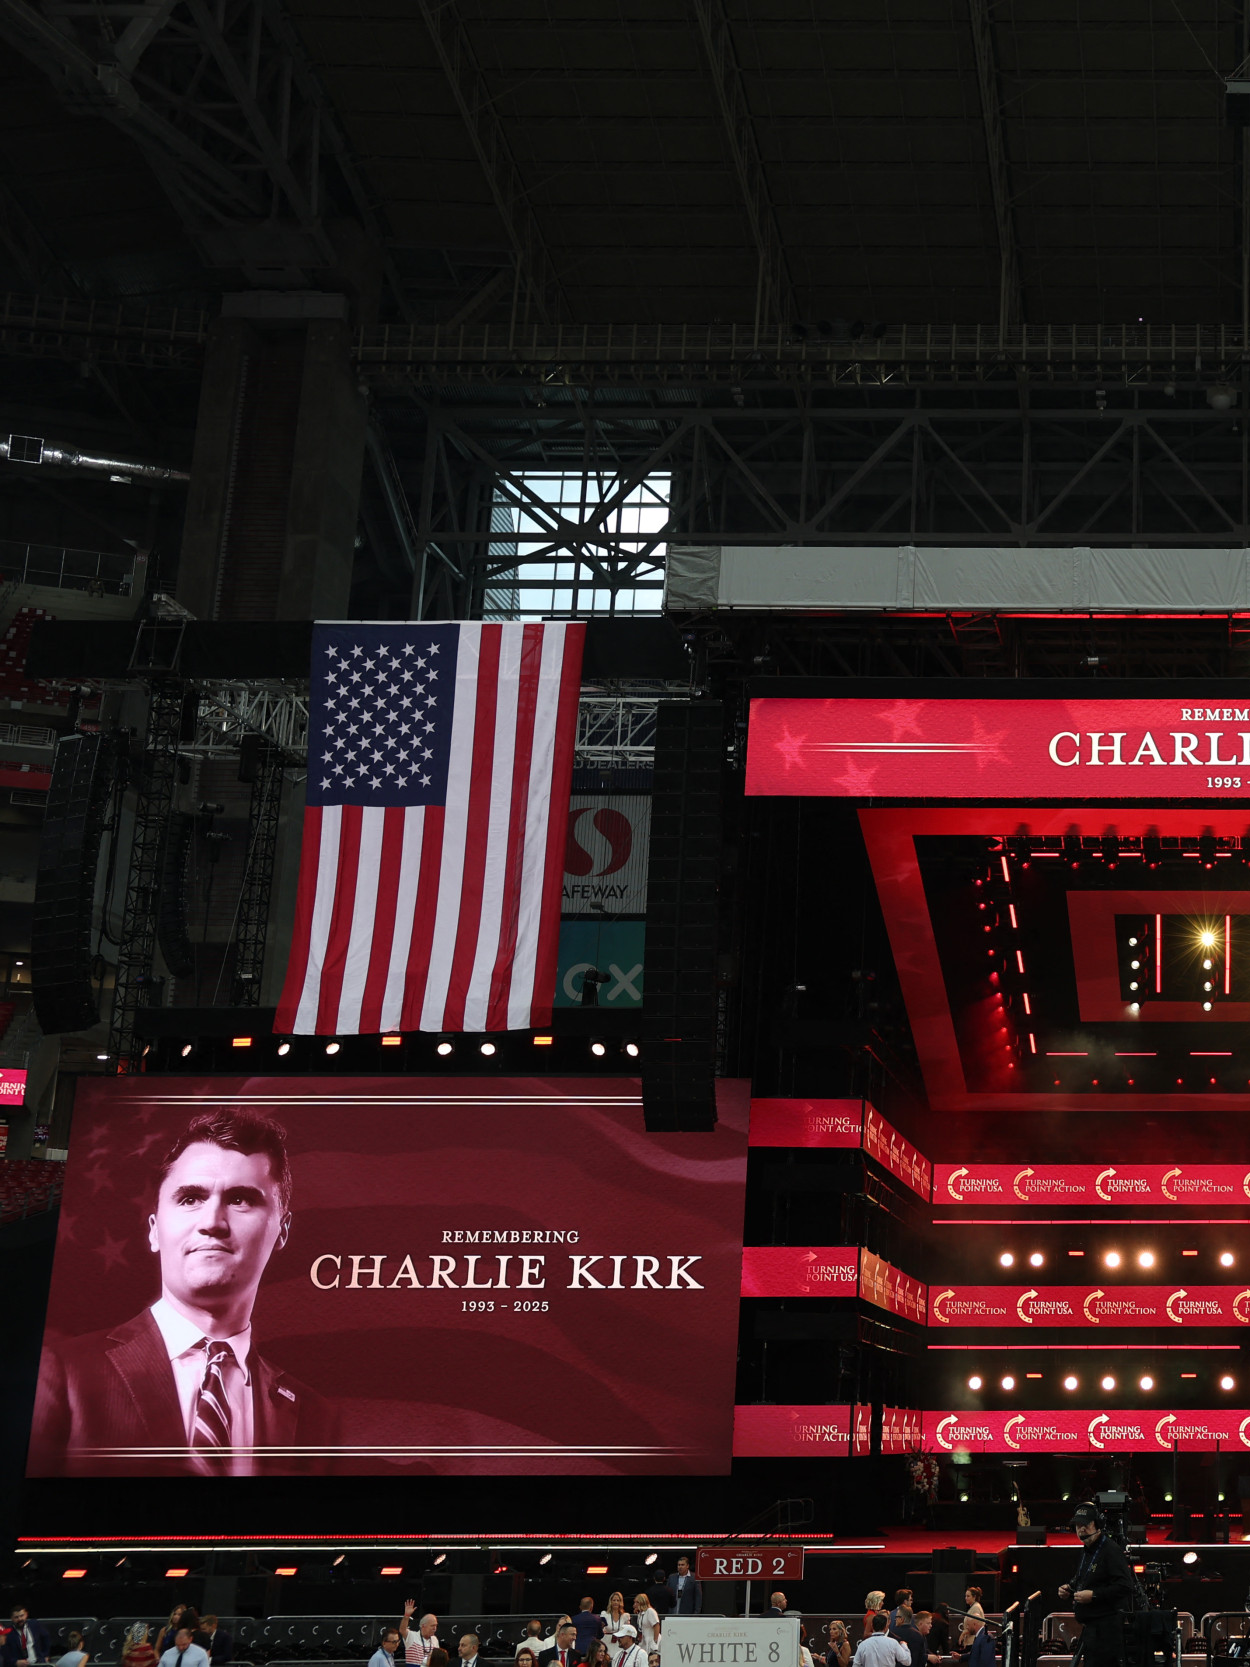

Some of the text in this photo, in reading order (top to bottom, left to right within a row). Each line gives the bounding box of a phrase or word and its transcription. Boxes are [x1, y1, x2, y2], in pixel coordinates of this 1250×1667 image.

[1206, 777, 1241, 788] 1993
[562, 884, 628, 899] AFEWAY
[562, 962, 644, 1001] OX
[808, 1117, 850, 1125] URNING
[808, 1124, 834, 1133] OINT
[441, 1230, 580, 1244] REMEMBERING
[309, 1254, 705, 1290] CHARLIE KIRK
[806, 1265, 855, 1274] TURNING
[806, 1273, 839, 1282] POINT
[461, 1301, 495, 1312] 1993
[513, 1301, 549, 1312] 2025
[1029, 1307, 1074, 1315] POINT USA
[1095, 1307, 1157, 1315] POINT ACTION
[794, 1425, 838, 1433] URNING
[794, 1432, 821, 1441] OINT
[949, 1432, 994, 1440] POINT USA
[1016, 1432, 1078, 1440] POINT ACTION
[713, 1557, 785, 1575] RED 2
[676, 1641, 780, 1663] WHITE 8
